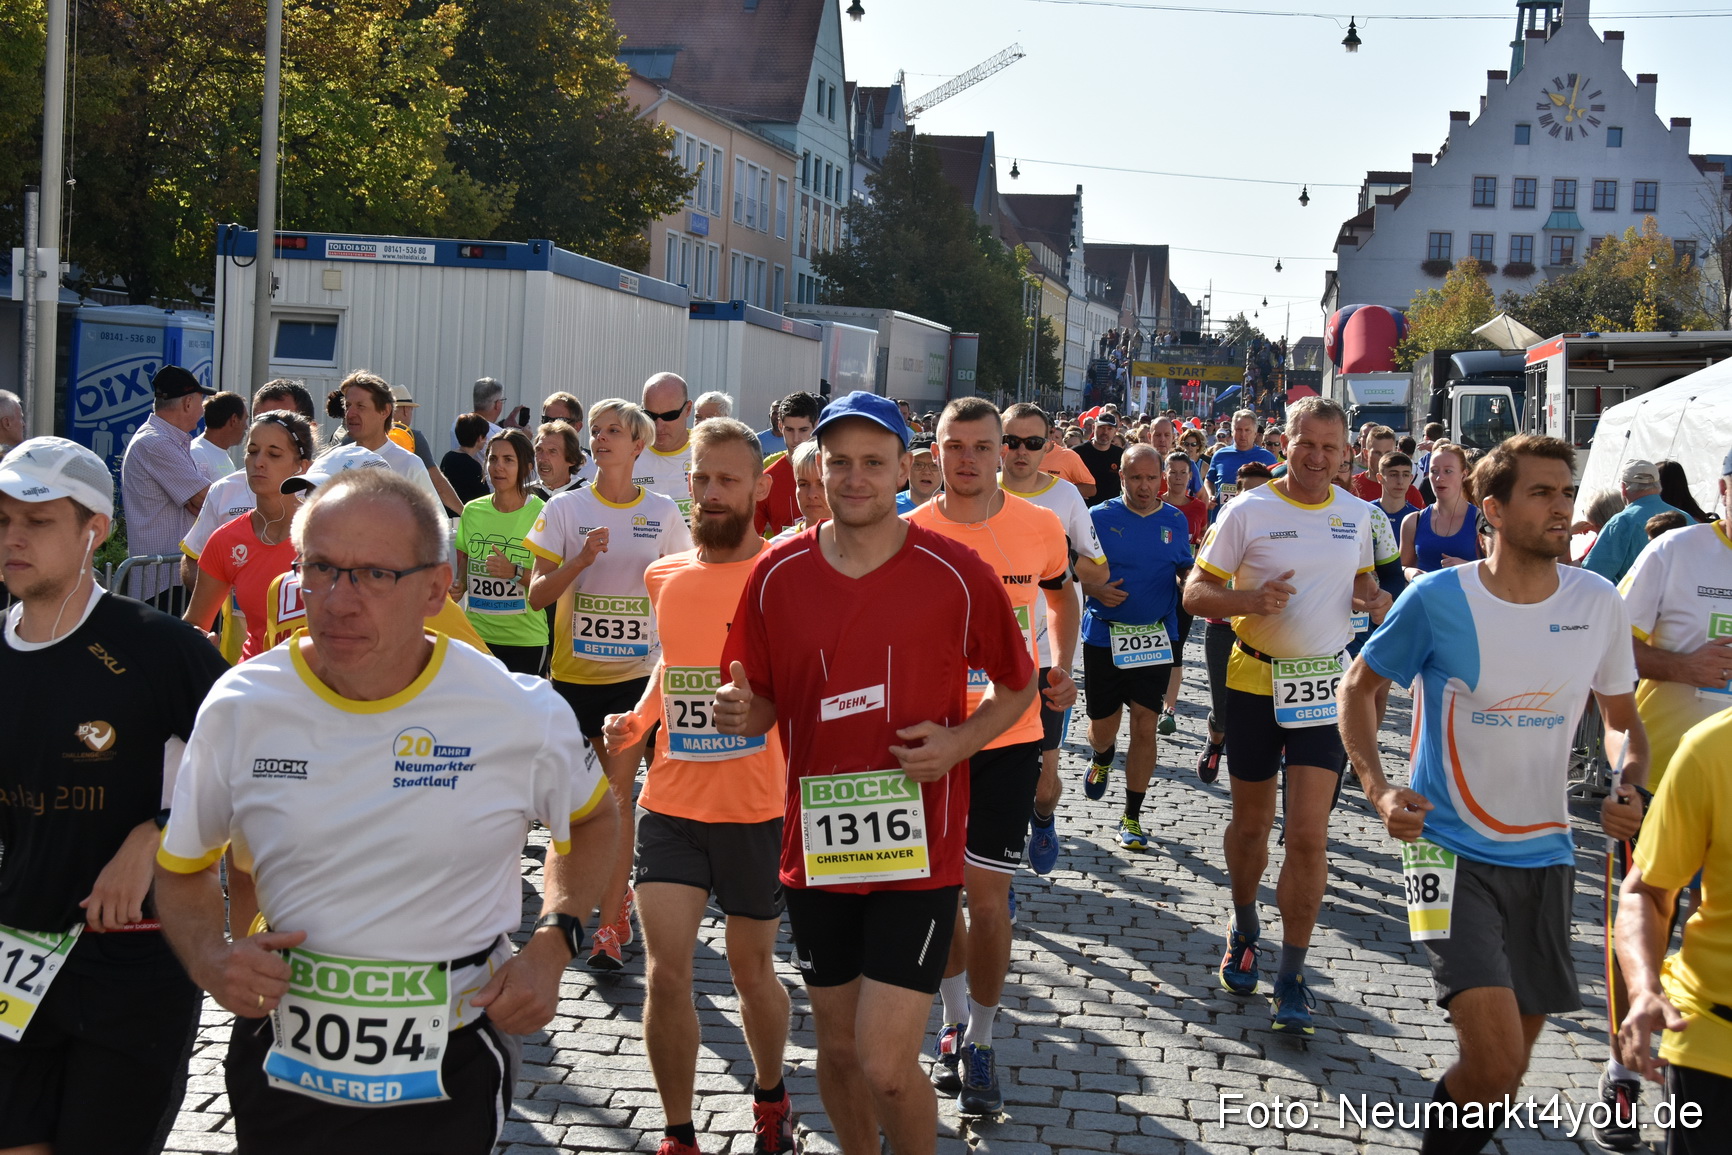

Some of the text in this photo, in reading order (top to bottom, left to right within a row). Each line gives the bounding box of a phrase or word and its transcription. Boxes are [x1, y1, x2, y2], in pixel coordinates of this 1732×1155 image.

[100, 331, 122, 340] 08141
[1168, 366, 1207, 377] START
[22, 486, 50, 496] sailfish
[633, 517, 647, 525] 20
[1330, 517, 1343, 527] 20
[473, 578, 517, 597] 2802
[1002, 575, 1032, 584] THULE
[474, 599, 518, 608] CHRISTINE
[580, 598, 646, 614] BOCK
[580, 617, 641, 640] 2633
[584, 643, 636, 655] BETTINA
[1118, 635, 1164, 651] 2032
[87, 642, 126, 675] 2XU
[1123, 652, 1163, 663] CLAUDIO
[670, 672, 721, 690] BOC
[839, 695, 867, 711] DEHN
[1472, 712, 1565, 729] BSX Energie
[397, 735, 468, 757] 20 JAHRE
[682, 736, 747, 750] MARKUS
[253, 759, 308, 774] BOCK
[395, 760, 476, 772] Neumarkter
[393, 776, 458, 790] Stadtlauf
[810, 775, 910, 805] BOCK
[54, 786, 104, 811] 2011
[816, 809, 911, 846] 1316
[816, 849, 914, 864] CHRISTIAN XAVER
[0, 941, 46, 993] 12
[289, 953, 436, 1001] BOCK
[432, 1018, 440, 1028] D
[288, 1004, 426, 1065] 2054
[300, 1074, 402, 1103] ALFRED
